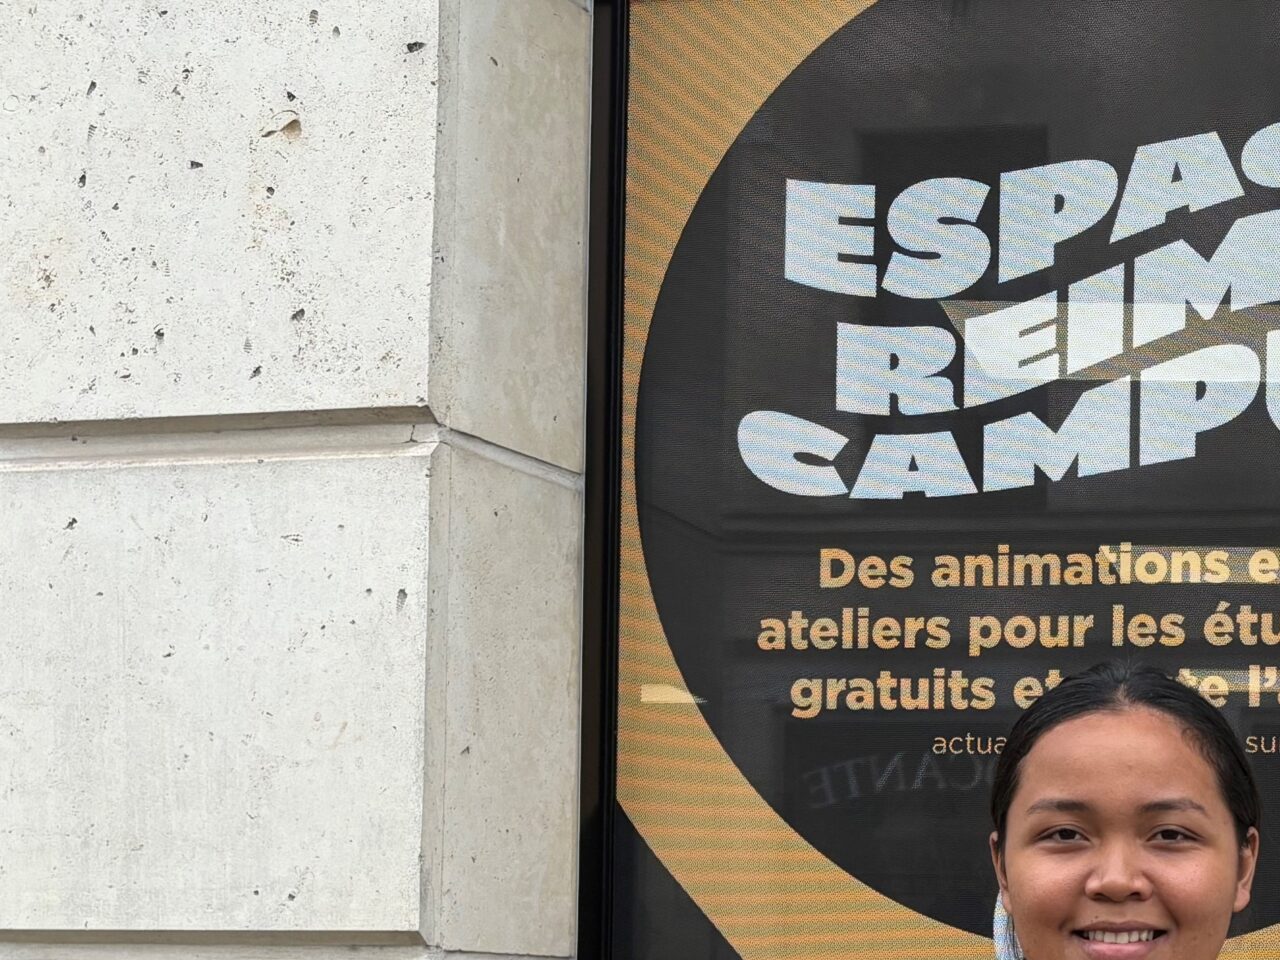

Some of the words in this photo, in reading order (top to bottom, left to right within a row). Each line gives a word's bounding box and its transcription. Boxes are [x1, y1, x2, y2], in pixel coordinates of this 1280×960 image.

[820, 548, 914, 588] Des
[931, 542, 1231, 587] animations
[757, 607, 951, 650] ateliers
[968, 614, 1094, 656] pour
[1112, 604, 1186, 647] les
[790, 668, 996, 719] gratuits
[932, 732, 1008, 755] actua
